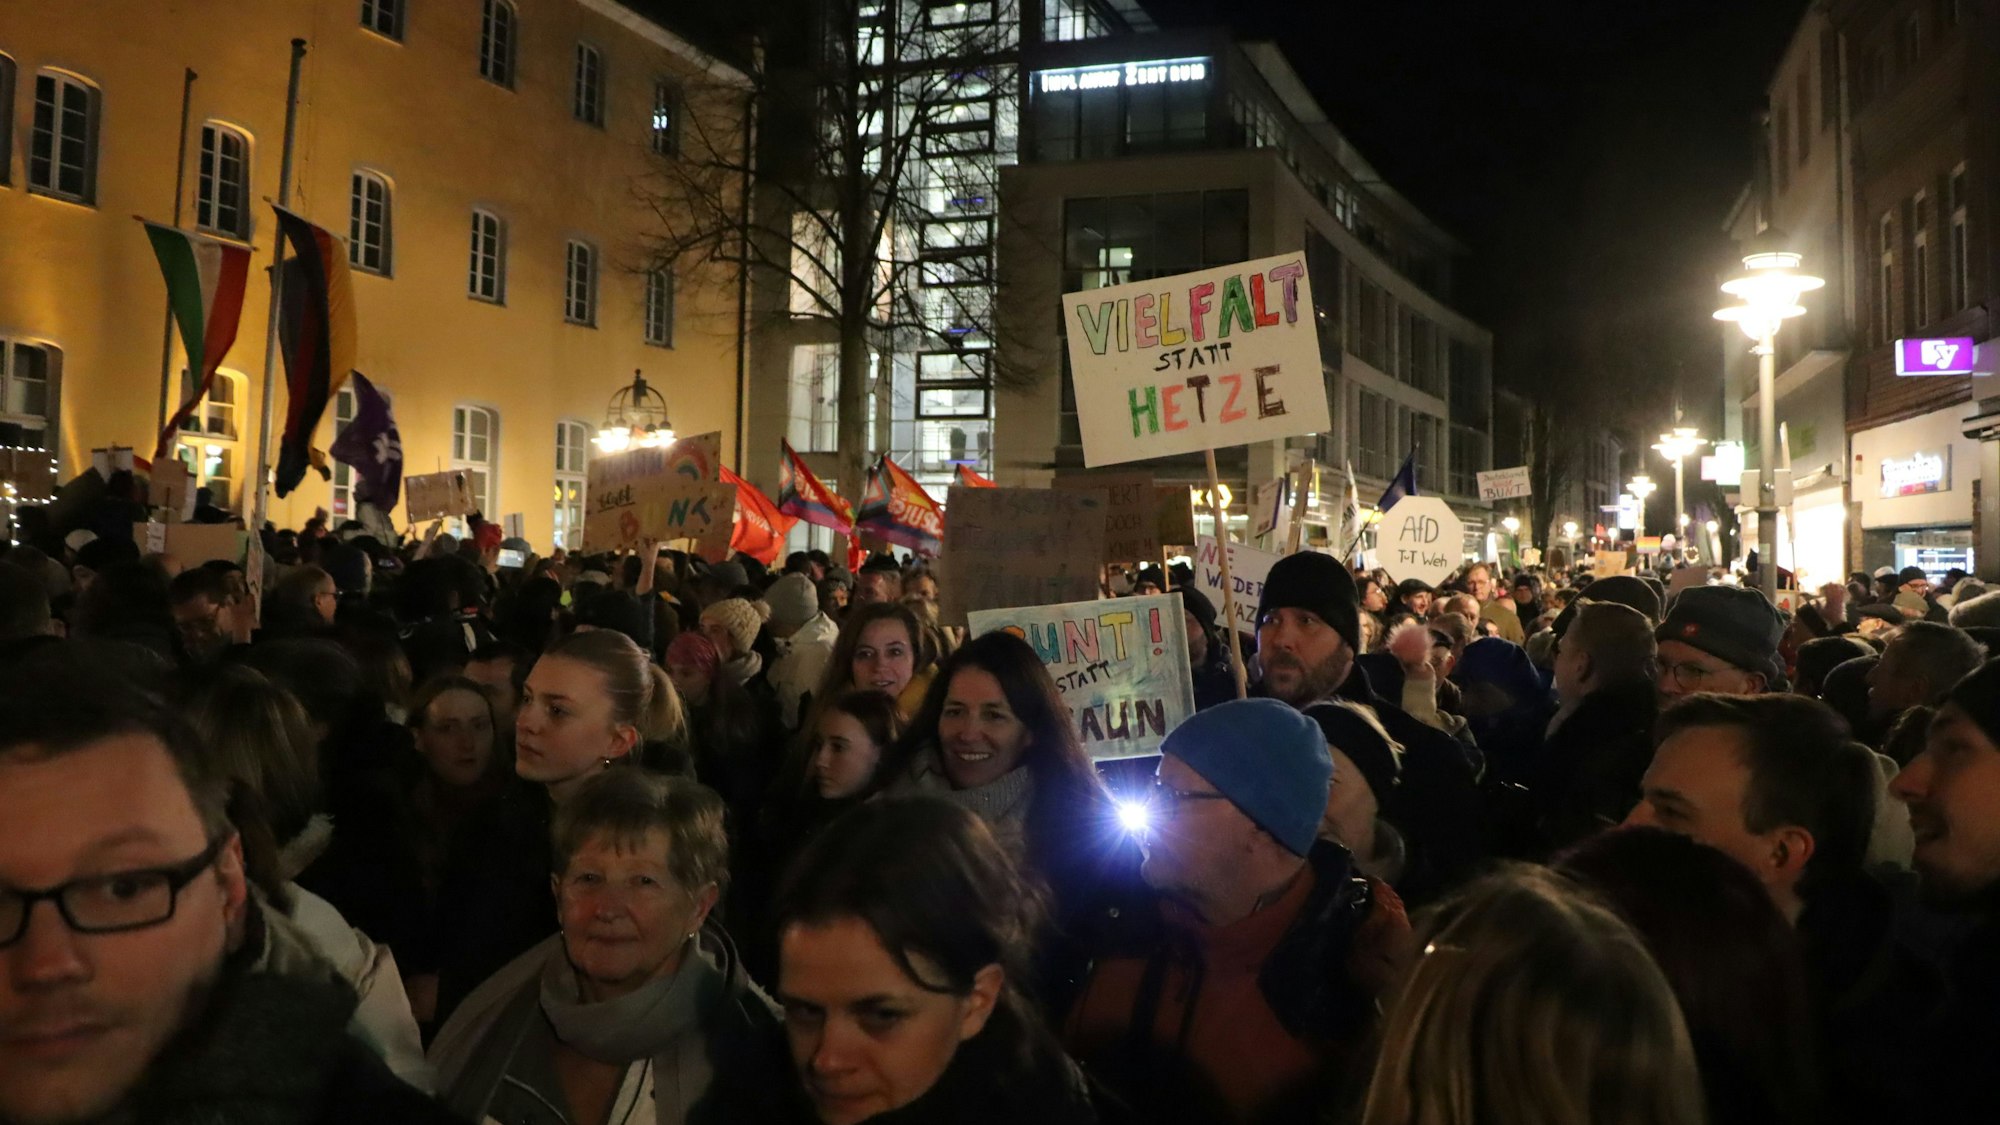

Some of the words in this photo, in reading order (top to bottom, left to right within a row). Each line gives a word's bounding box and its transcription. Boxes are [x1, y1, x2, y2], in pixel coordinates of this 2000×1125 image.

[1076, 260, 1304, 355] VIELFALT
[1153, 342, 1232, 372] STATT
[1128, 364, 1290, 438] HETZE
[1484, 483, 1525, 498] BUNT
[1399, 514, 1439, 544] AfD
[1422, 551, 1448, 568] Weh
[1206, 568, 1264, 597] WDER
[999, 608, 1163, 665] UNT!
[1056, 660, 1111, 693] STATT
